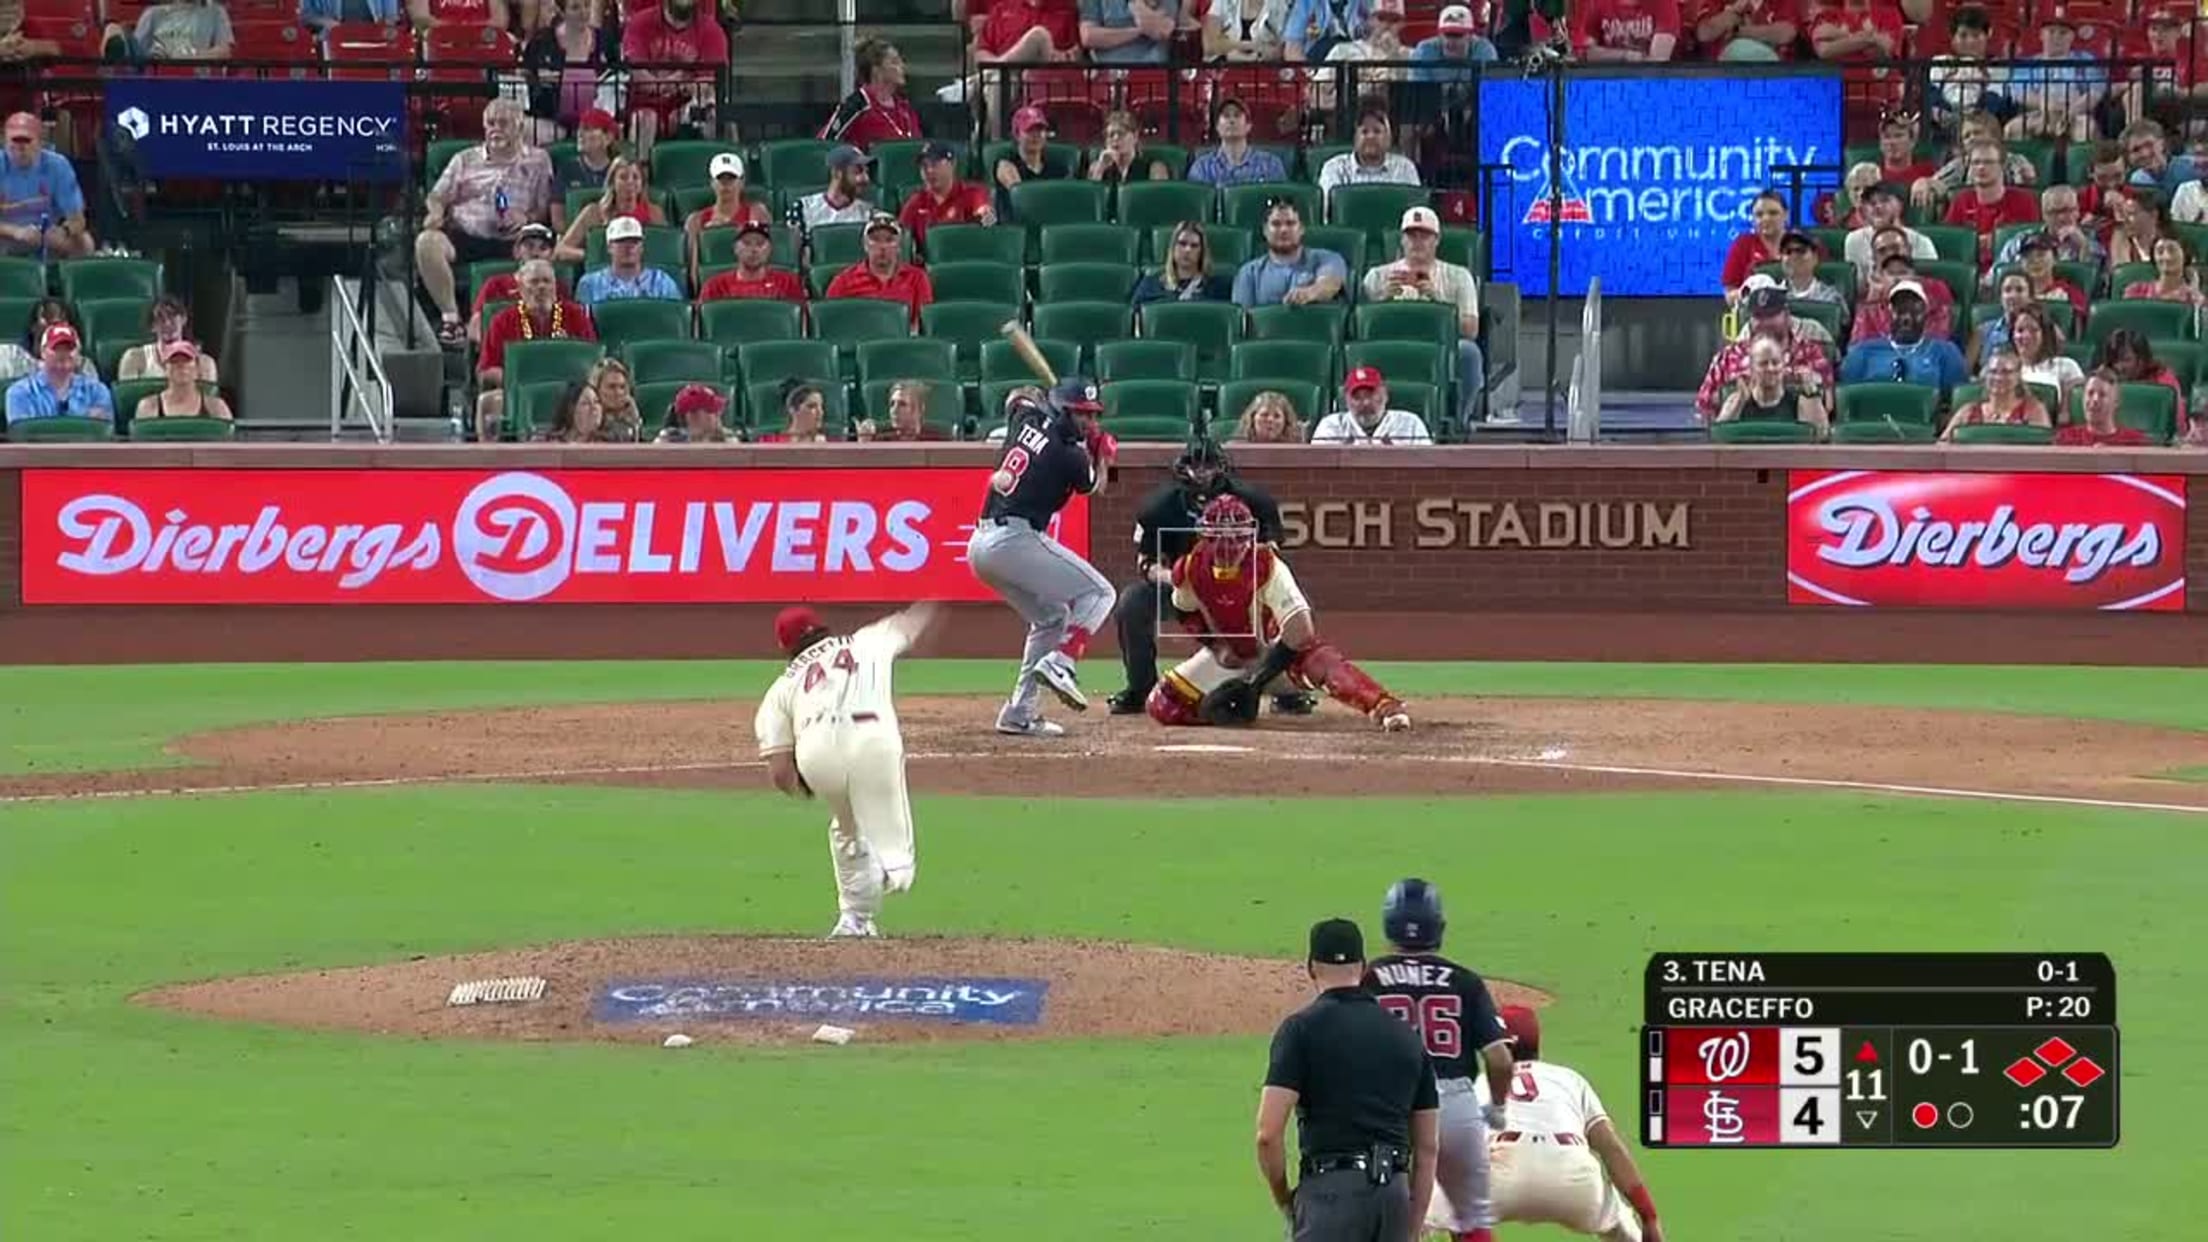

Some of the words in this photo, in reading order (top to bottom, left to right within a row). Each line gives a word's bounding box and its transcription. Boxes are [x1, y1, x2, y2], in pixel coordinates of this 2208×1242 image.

[161, 114, 255, 135] HYATT
[263, 115, 392, 137] REGENCY
[222, 142, 250, 152] LOUIS
[252, 142, 264, 152] AT
[266, 142, 285, 152] THE
[287, 142, 313, 152] ARCH
[1501, 135, 1817, 186] Community
[1017, 424, 1049, 455] TENA
[993, 446, 1030, 497] 8
[57, 493, 441, 589] Dierbergs
[474, 492, 932, 576] DELIVERS
[1278, 502, 1392, 547] SCH
[1416, 498, 1689, 547] STADIUM
[1817, 495, 2161, 583] Dierbergs
